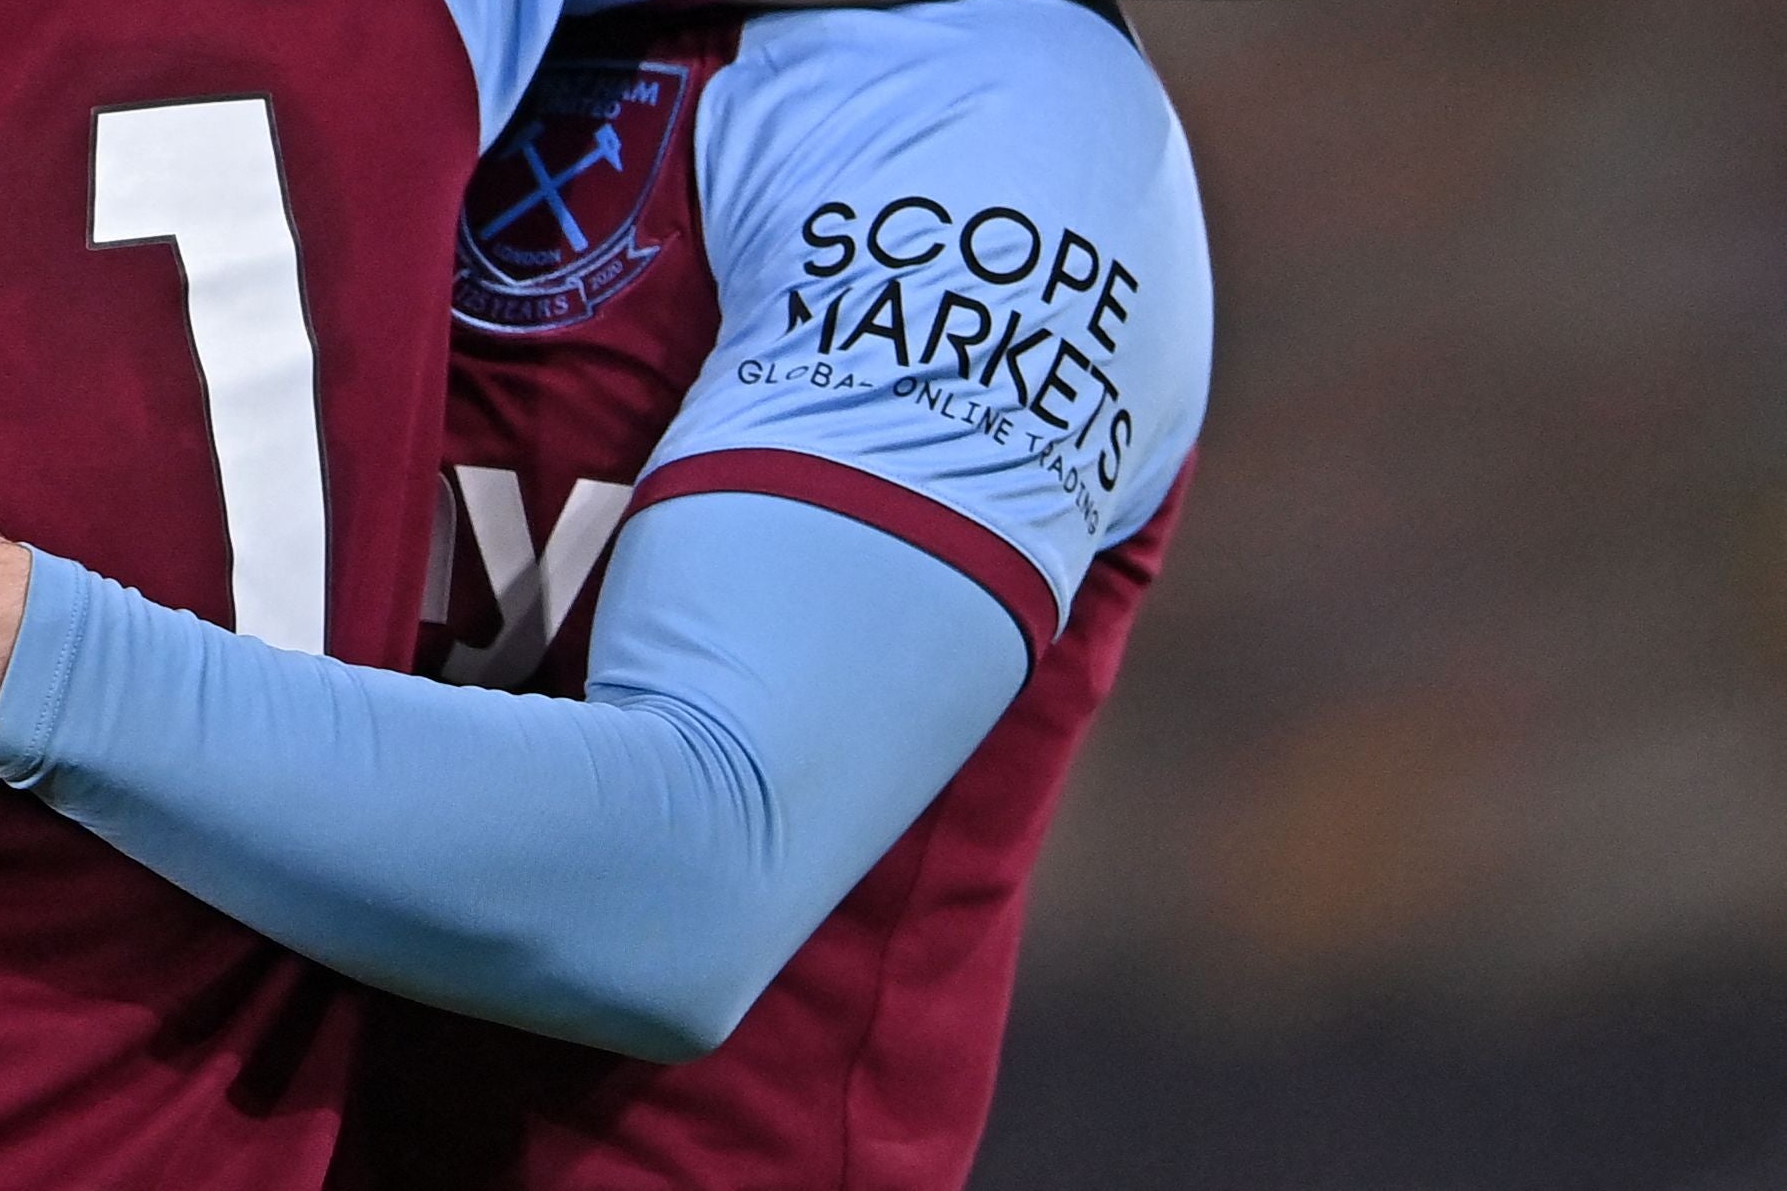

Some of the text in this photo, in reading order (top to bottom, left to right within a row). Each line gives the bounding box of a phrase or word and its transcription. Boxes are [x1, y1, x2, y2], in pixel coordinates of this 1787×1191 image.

[801, 195, 1139, 354] SCOPE
[737, 359, 874, 390] GLOBA
[893, 375, 1014, 446] ONLINE
[785, 279, 1133, 492] MARKETS
